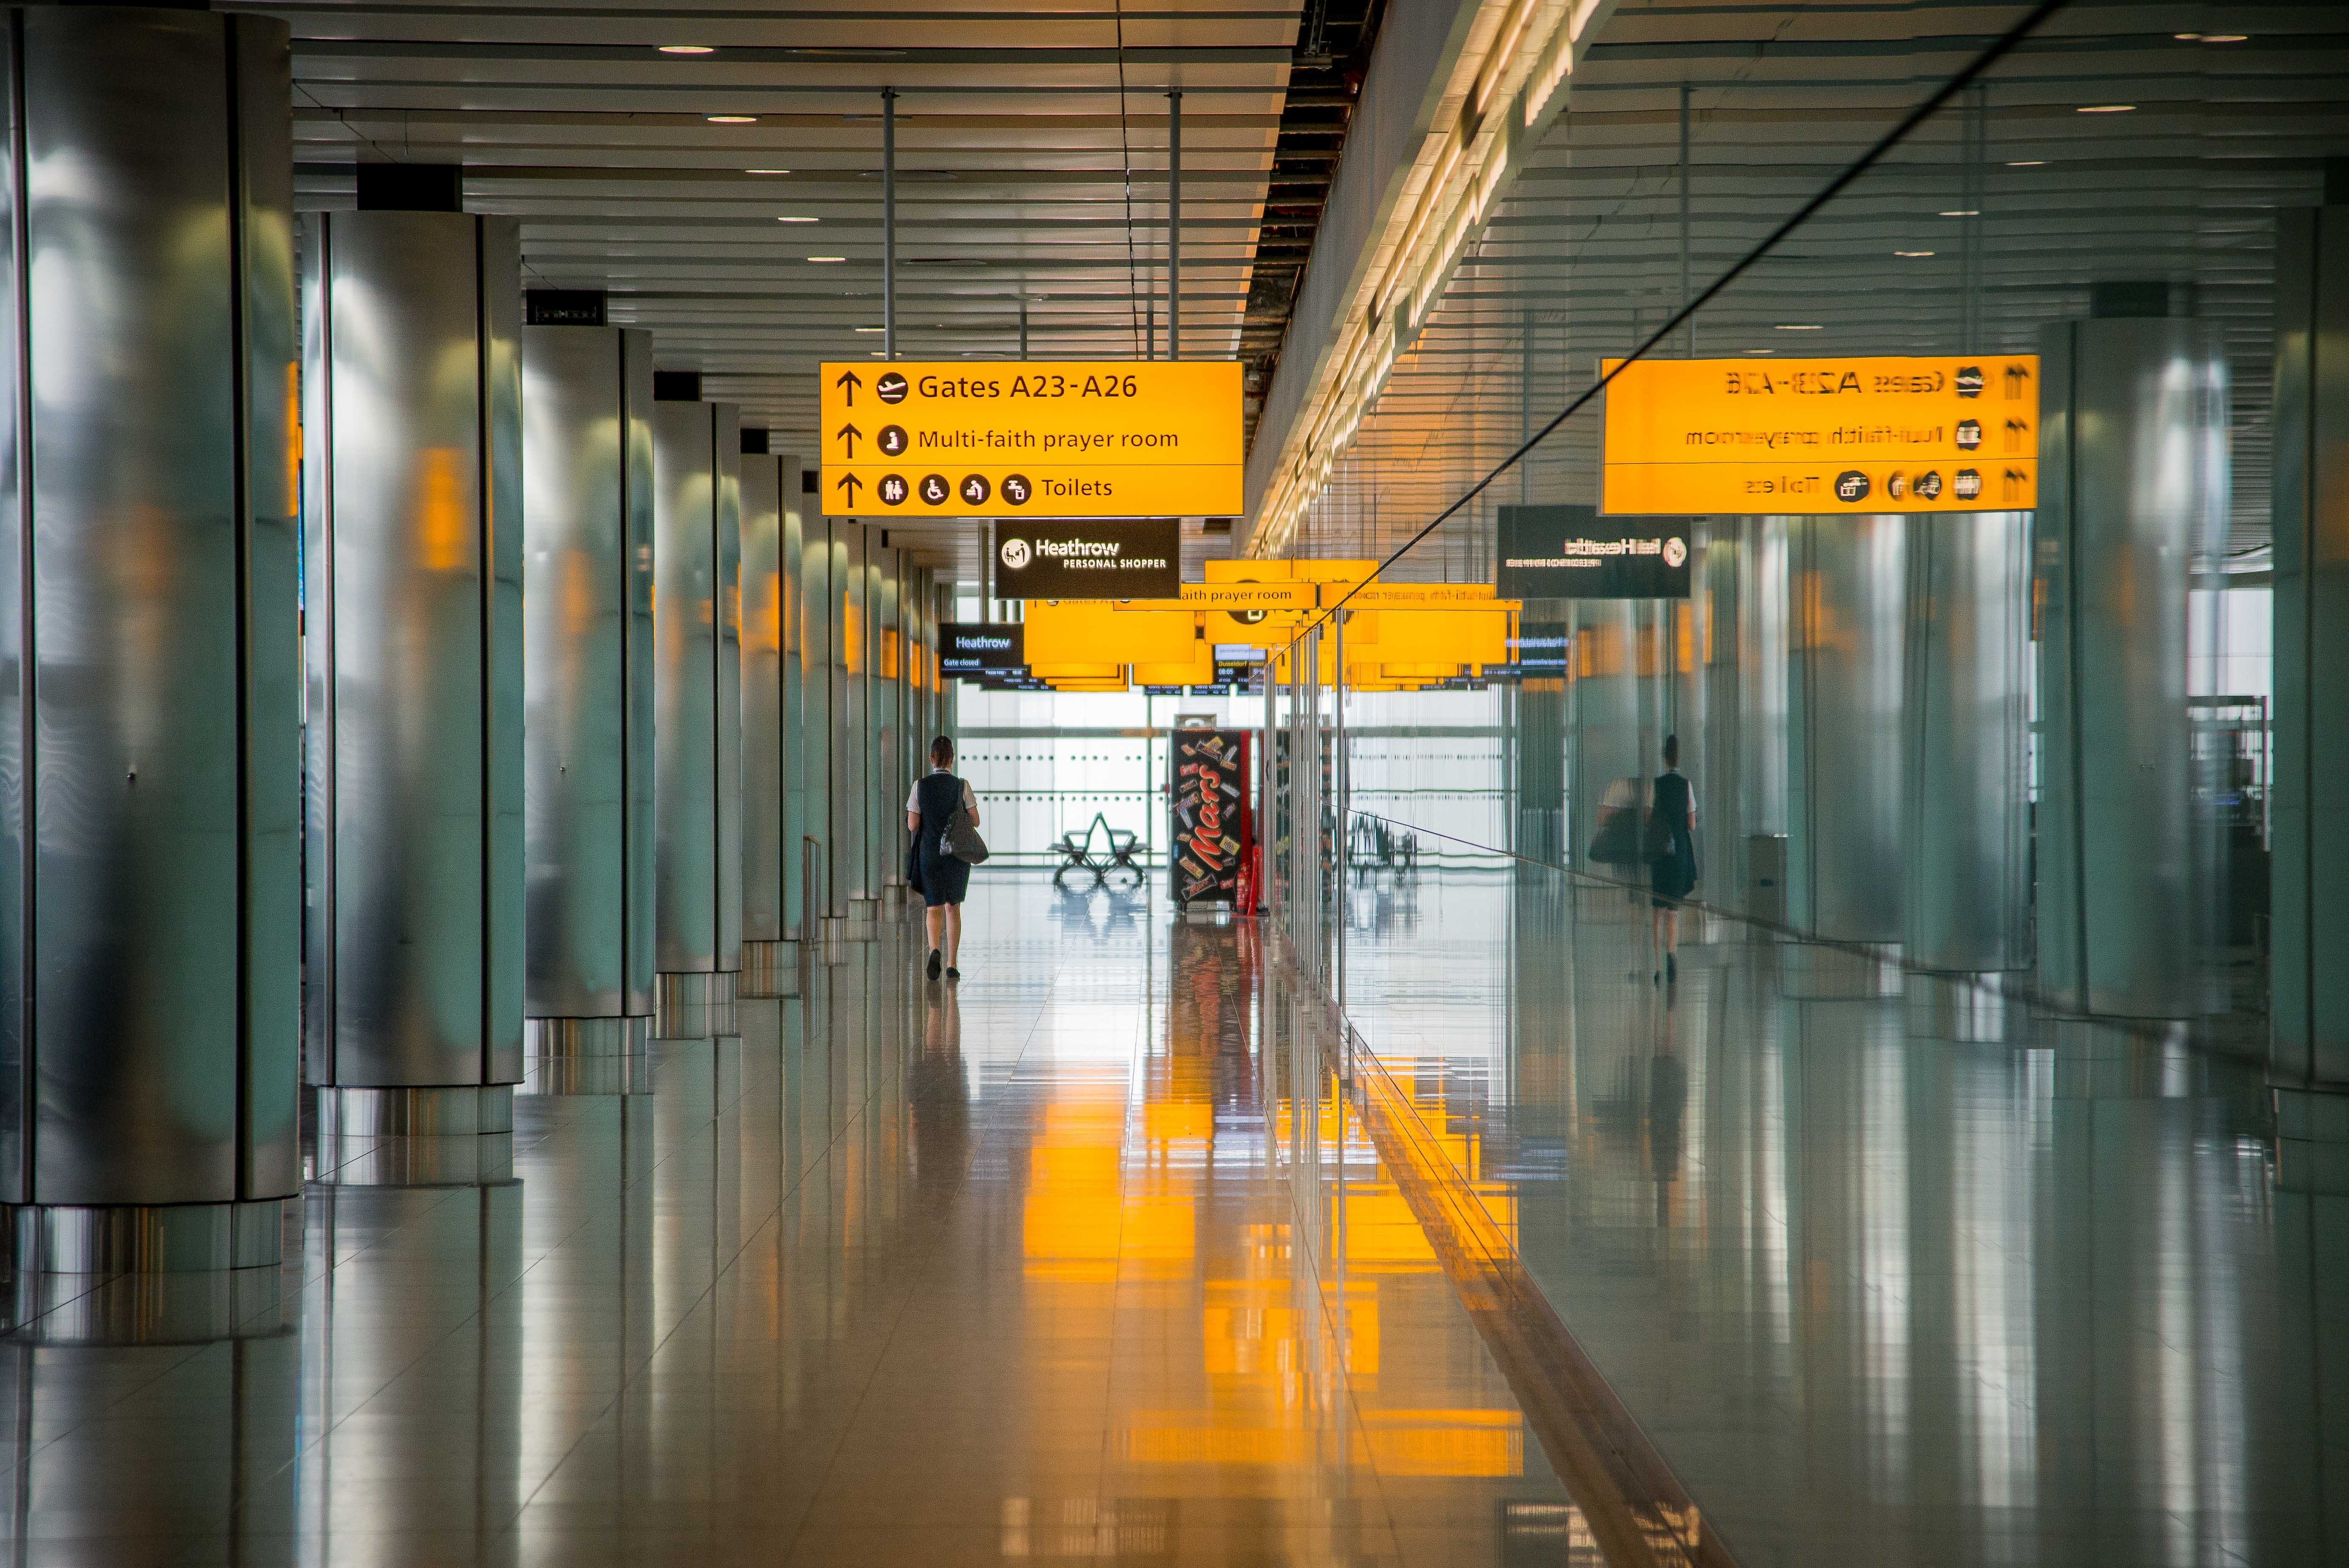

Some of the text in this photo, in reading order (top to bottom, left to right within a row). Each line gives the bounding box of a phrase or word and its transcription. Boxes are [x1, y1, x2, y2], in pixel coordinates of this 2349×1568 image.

[918, 374, 1137, 398] Gates A23-A26
[919, 429, 1178, 452] Multi-faith prayer room
[1041, 478, 1112, 496] Toilets
[1036, 537, 1120, 557] Heathrow
[1063, 558, 1166, 569] PERSONAL SHOPPER
[1182, 589, 1292, 603] aith prayer room
[956, 636, 1011, 648] Heathrow
[1190, 764, 1223, 871] Mars
